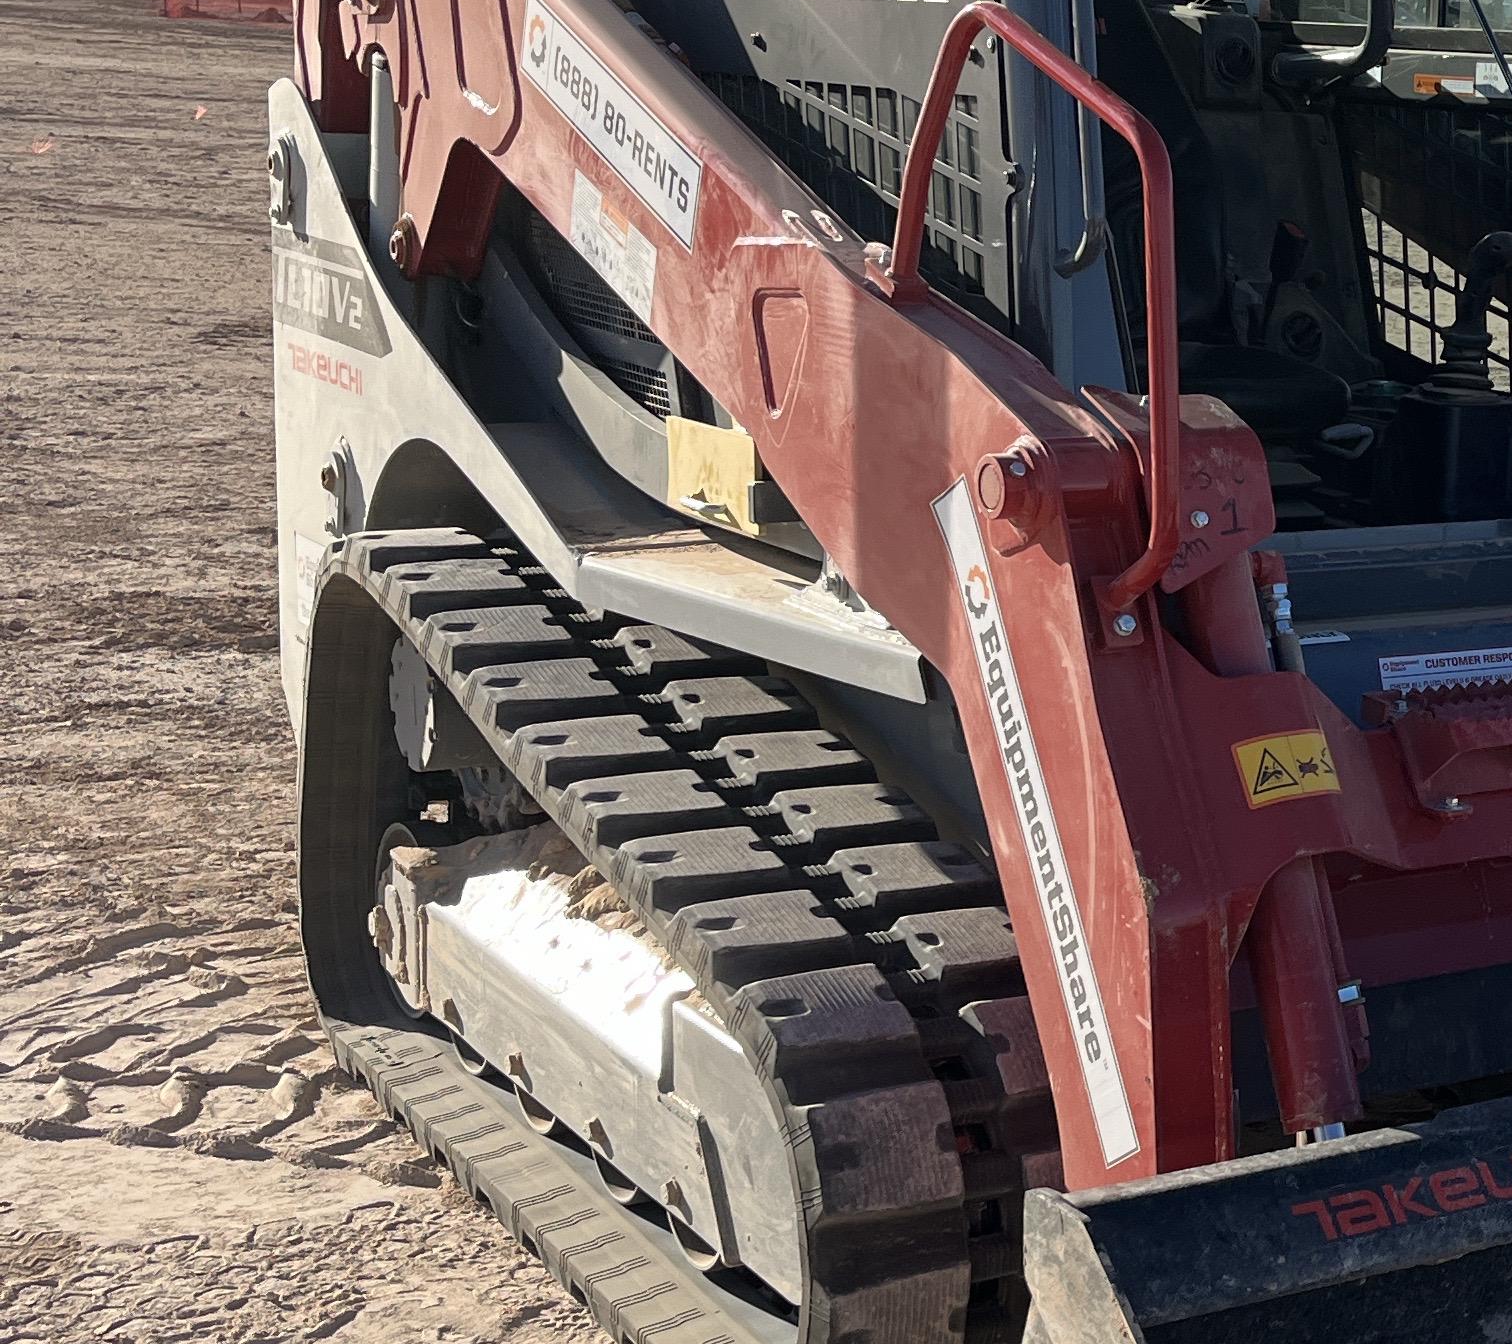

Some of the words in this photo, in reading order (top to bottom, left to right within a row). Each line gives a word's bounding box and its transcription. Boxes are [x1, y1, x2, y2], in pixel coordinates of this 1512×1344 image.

[554, 45, 600, 122] (888)
[603, 101, 691, 215] 80-RENTS
[1424, 655, 1482, 669] CUSTOMER
[978, 620, 1102, 1063] EquipmentShare
